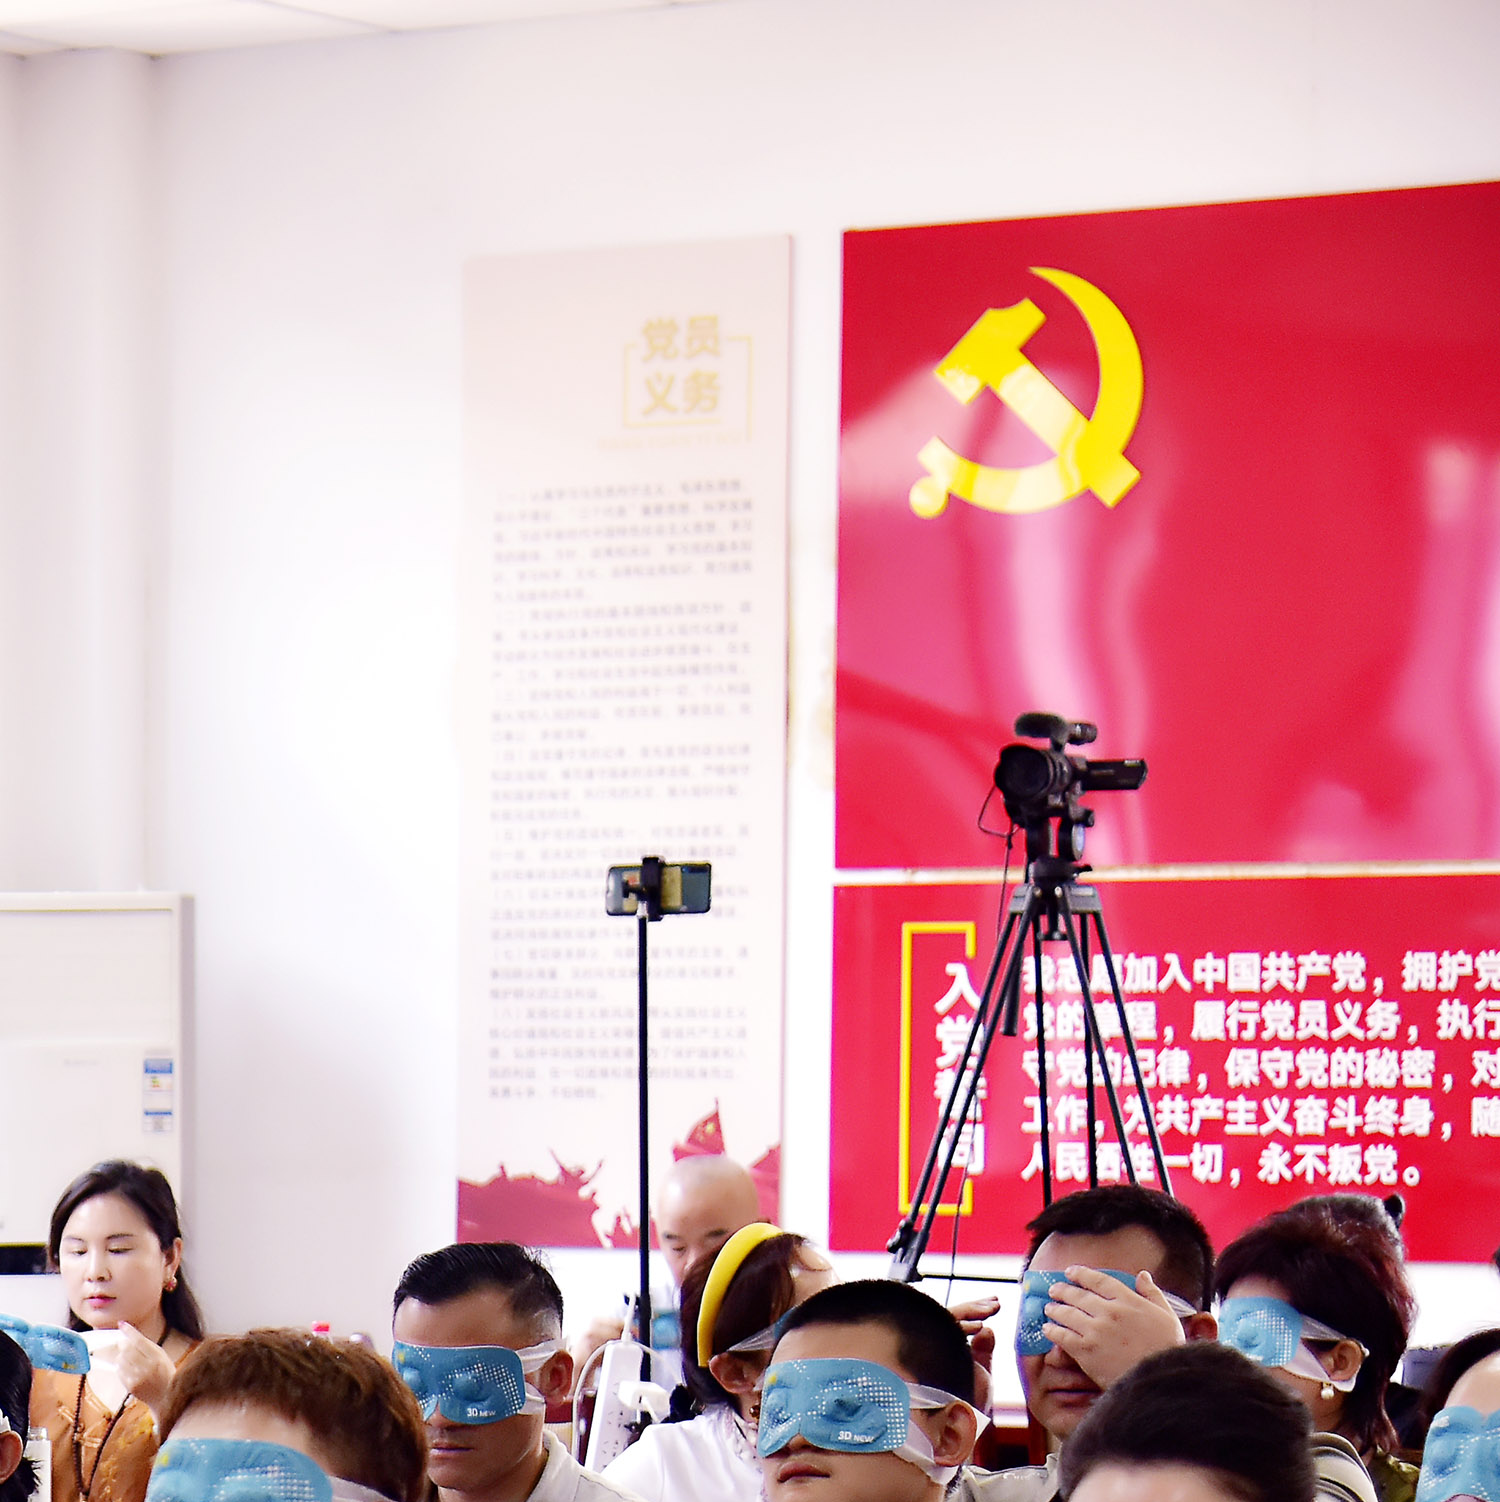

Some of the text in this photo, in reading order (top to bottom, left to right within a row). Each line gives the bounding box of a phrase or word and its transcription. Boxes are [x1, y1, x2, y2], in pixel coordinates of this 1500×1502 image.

[640, 315, 721, 363] 党员
[641, 370, 722, 416] 义务
[467, 1407, 478, 1417] 3D
[837, 1430, 852, 1440] 3D
